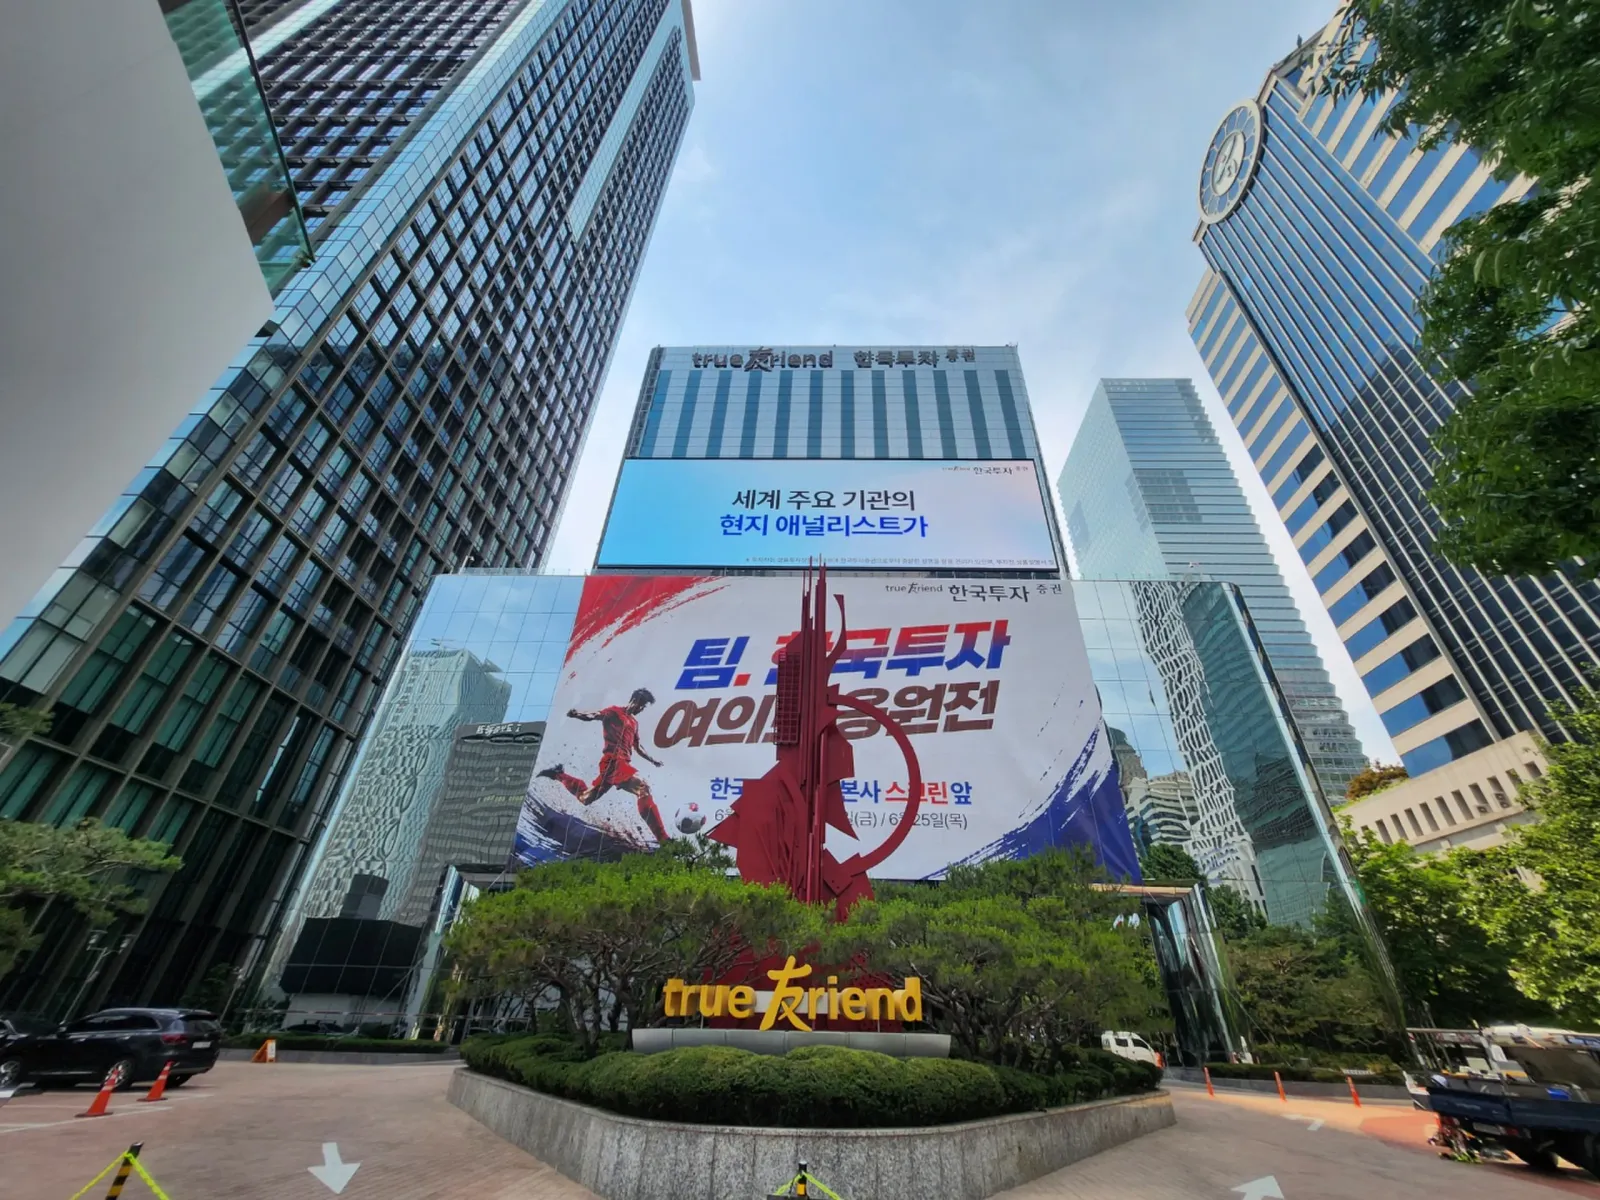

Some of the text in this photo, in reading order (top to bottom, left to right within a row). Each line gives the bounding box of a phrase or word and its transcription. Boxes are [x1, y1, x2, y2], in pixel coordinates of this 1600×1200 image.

[732, 489, 916, 511] 세계 주요 기관의
[720, 513, 929, 538] 현지 애널리스트가
[885, 584, 906, 593] true
[948, 583, 1063, 602] 한국투자 증권
[675, 635, 751, 690] 팀.
[653, 692, 779, 749] 여의
[950, 781, 972, 805] 앞
[663, 977, 757, 1018] true
